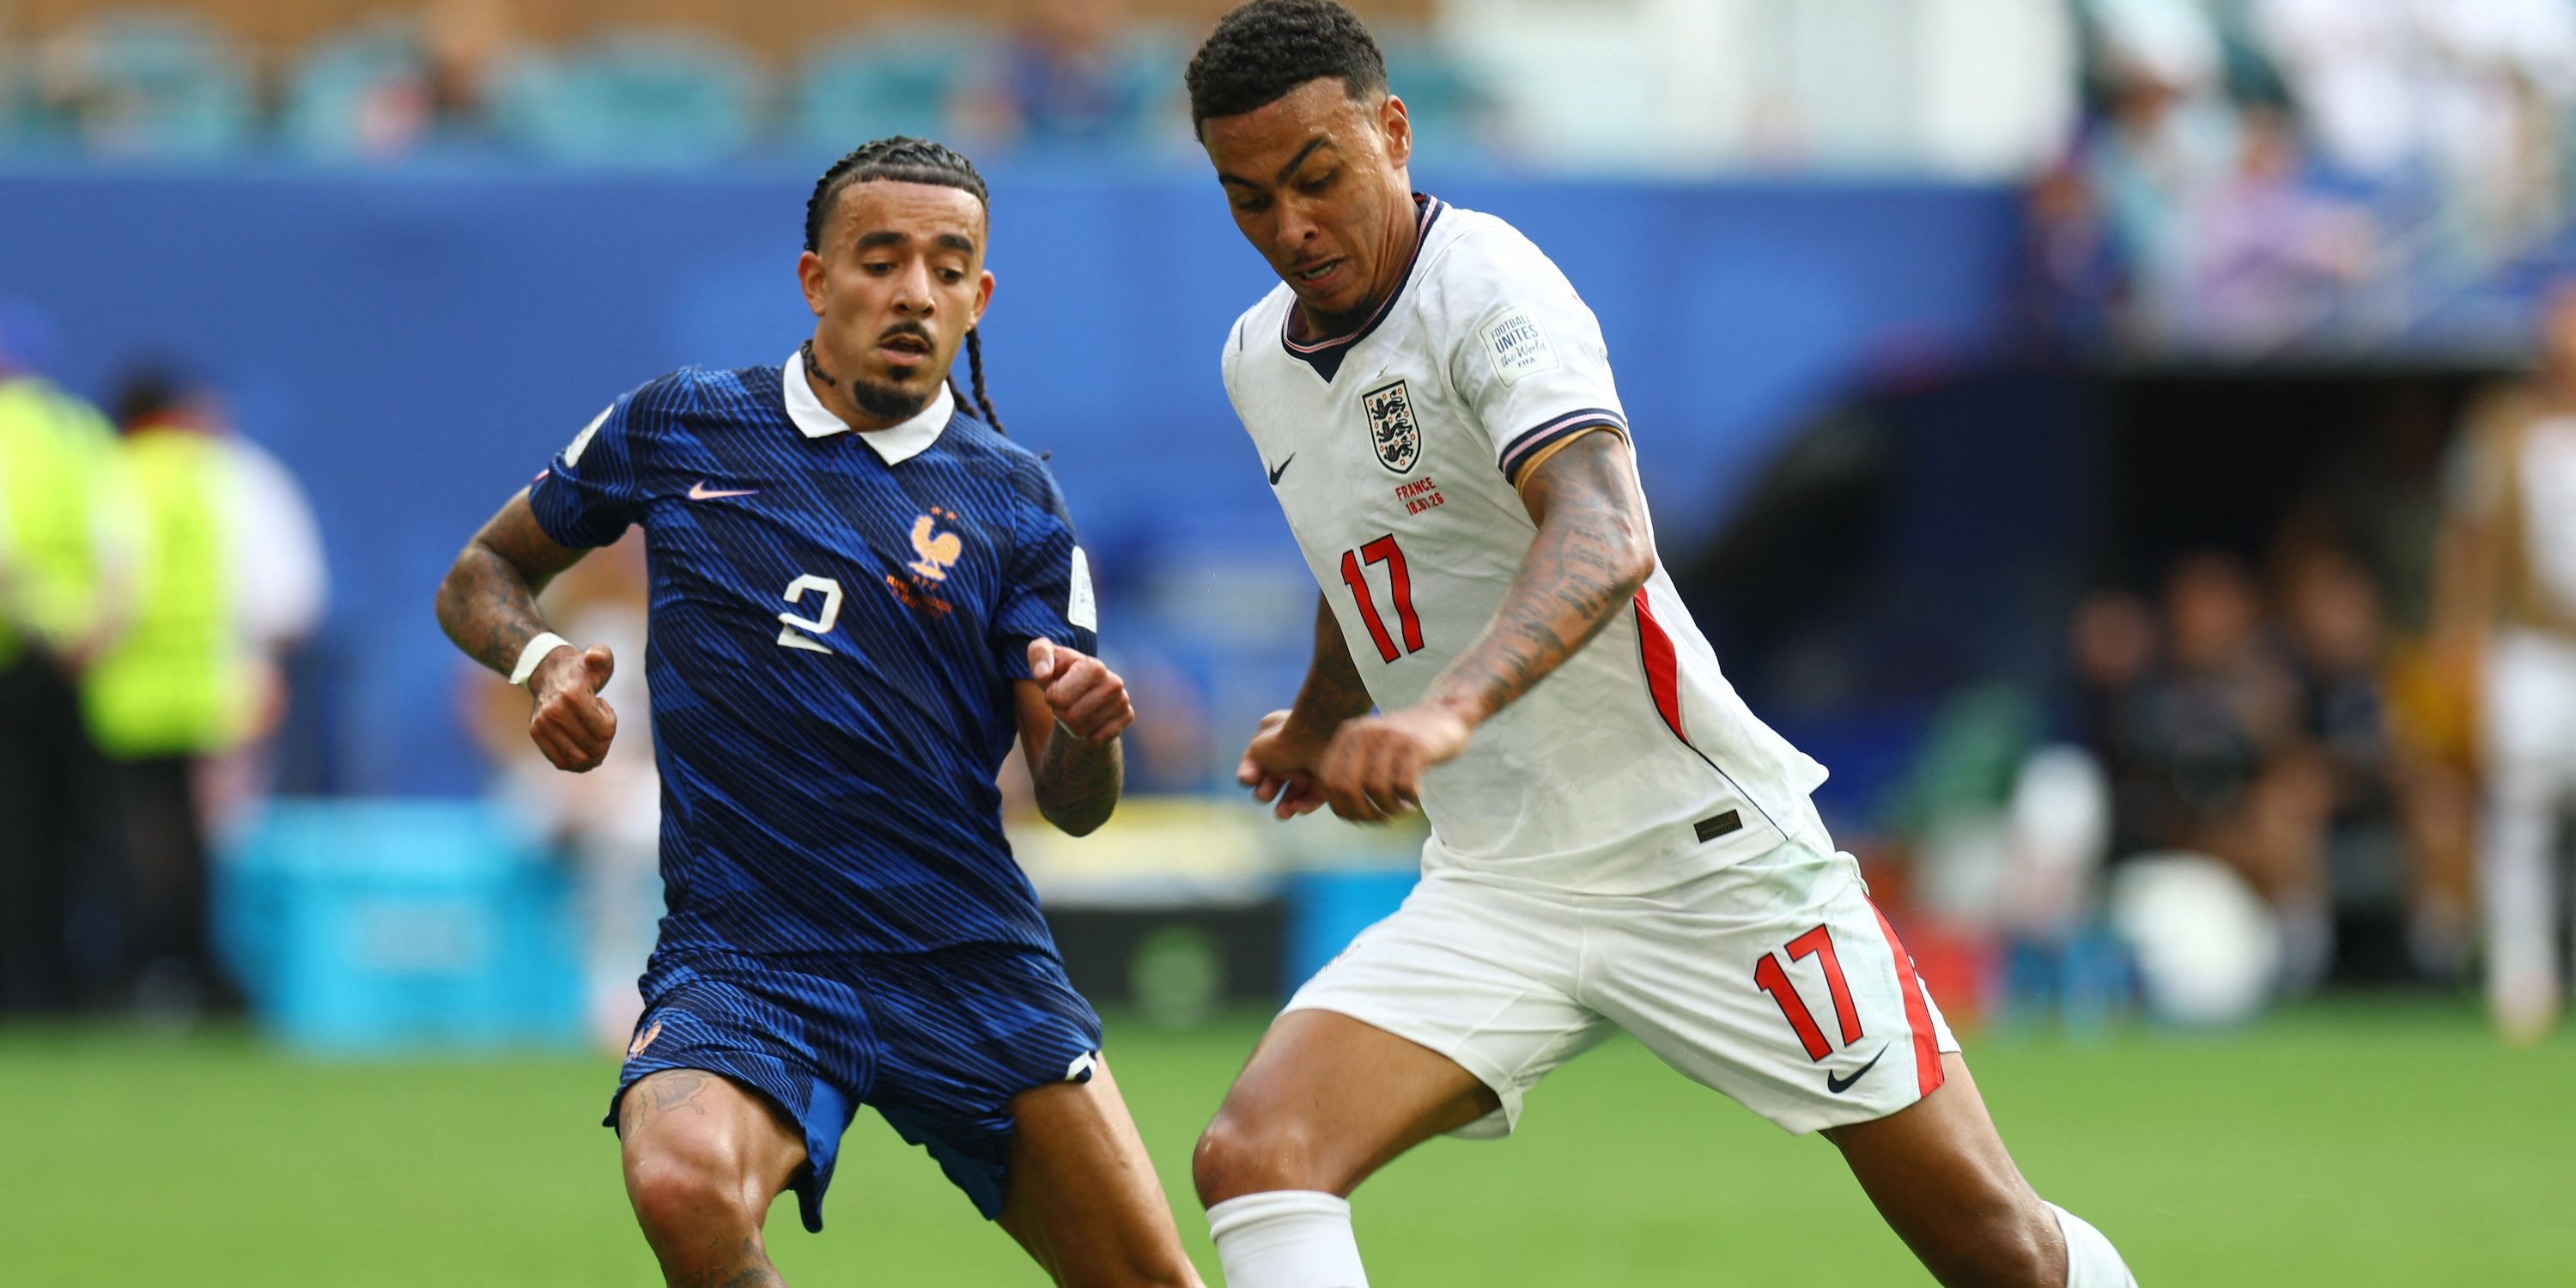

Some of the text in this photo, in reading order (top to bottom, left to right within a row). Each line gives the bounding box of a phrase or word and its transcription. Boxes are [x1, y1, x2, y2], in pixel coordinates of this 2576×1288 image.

[1491, 313, 1530, 340] FOOTBALL
[1495, 324, 1539, 354] UNITES
[1516, 339, 1546, 357] World
[1395, 477, 1436, 501] FRANCE
[1340, 533, 1425, 665] 17
[777, 574, 844, 655] 2
[1754, 923, 1864, 1063] 17
